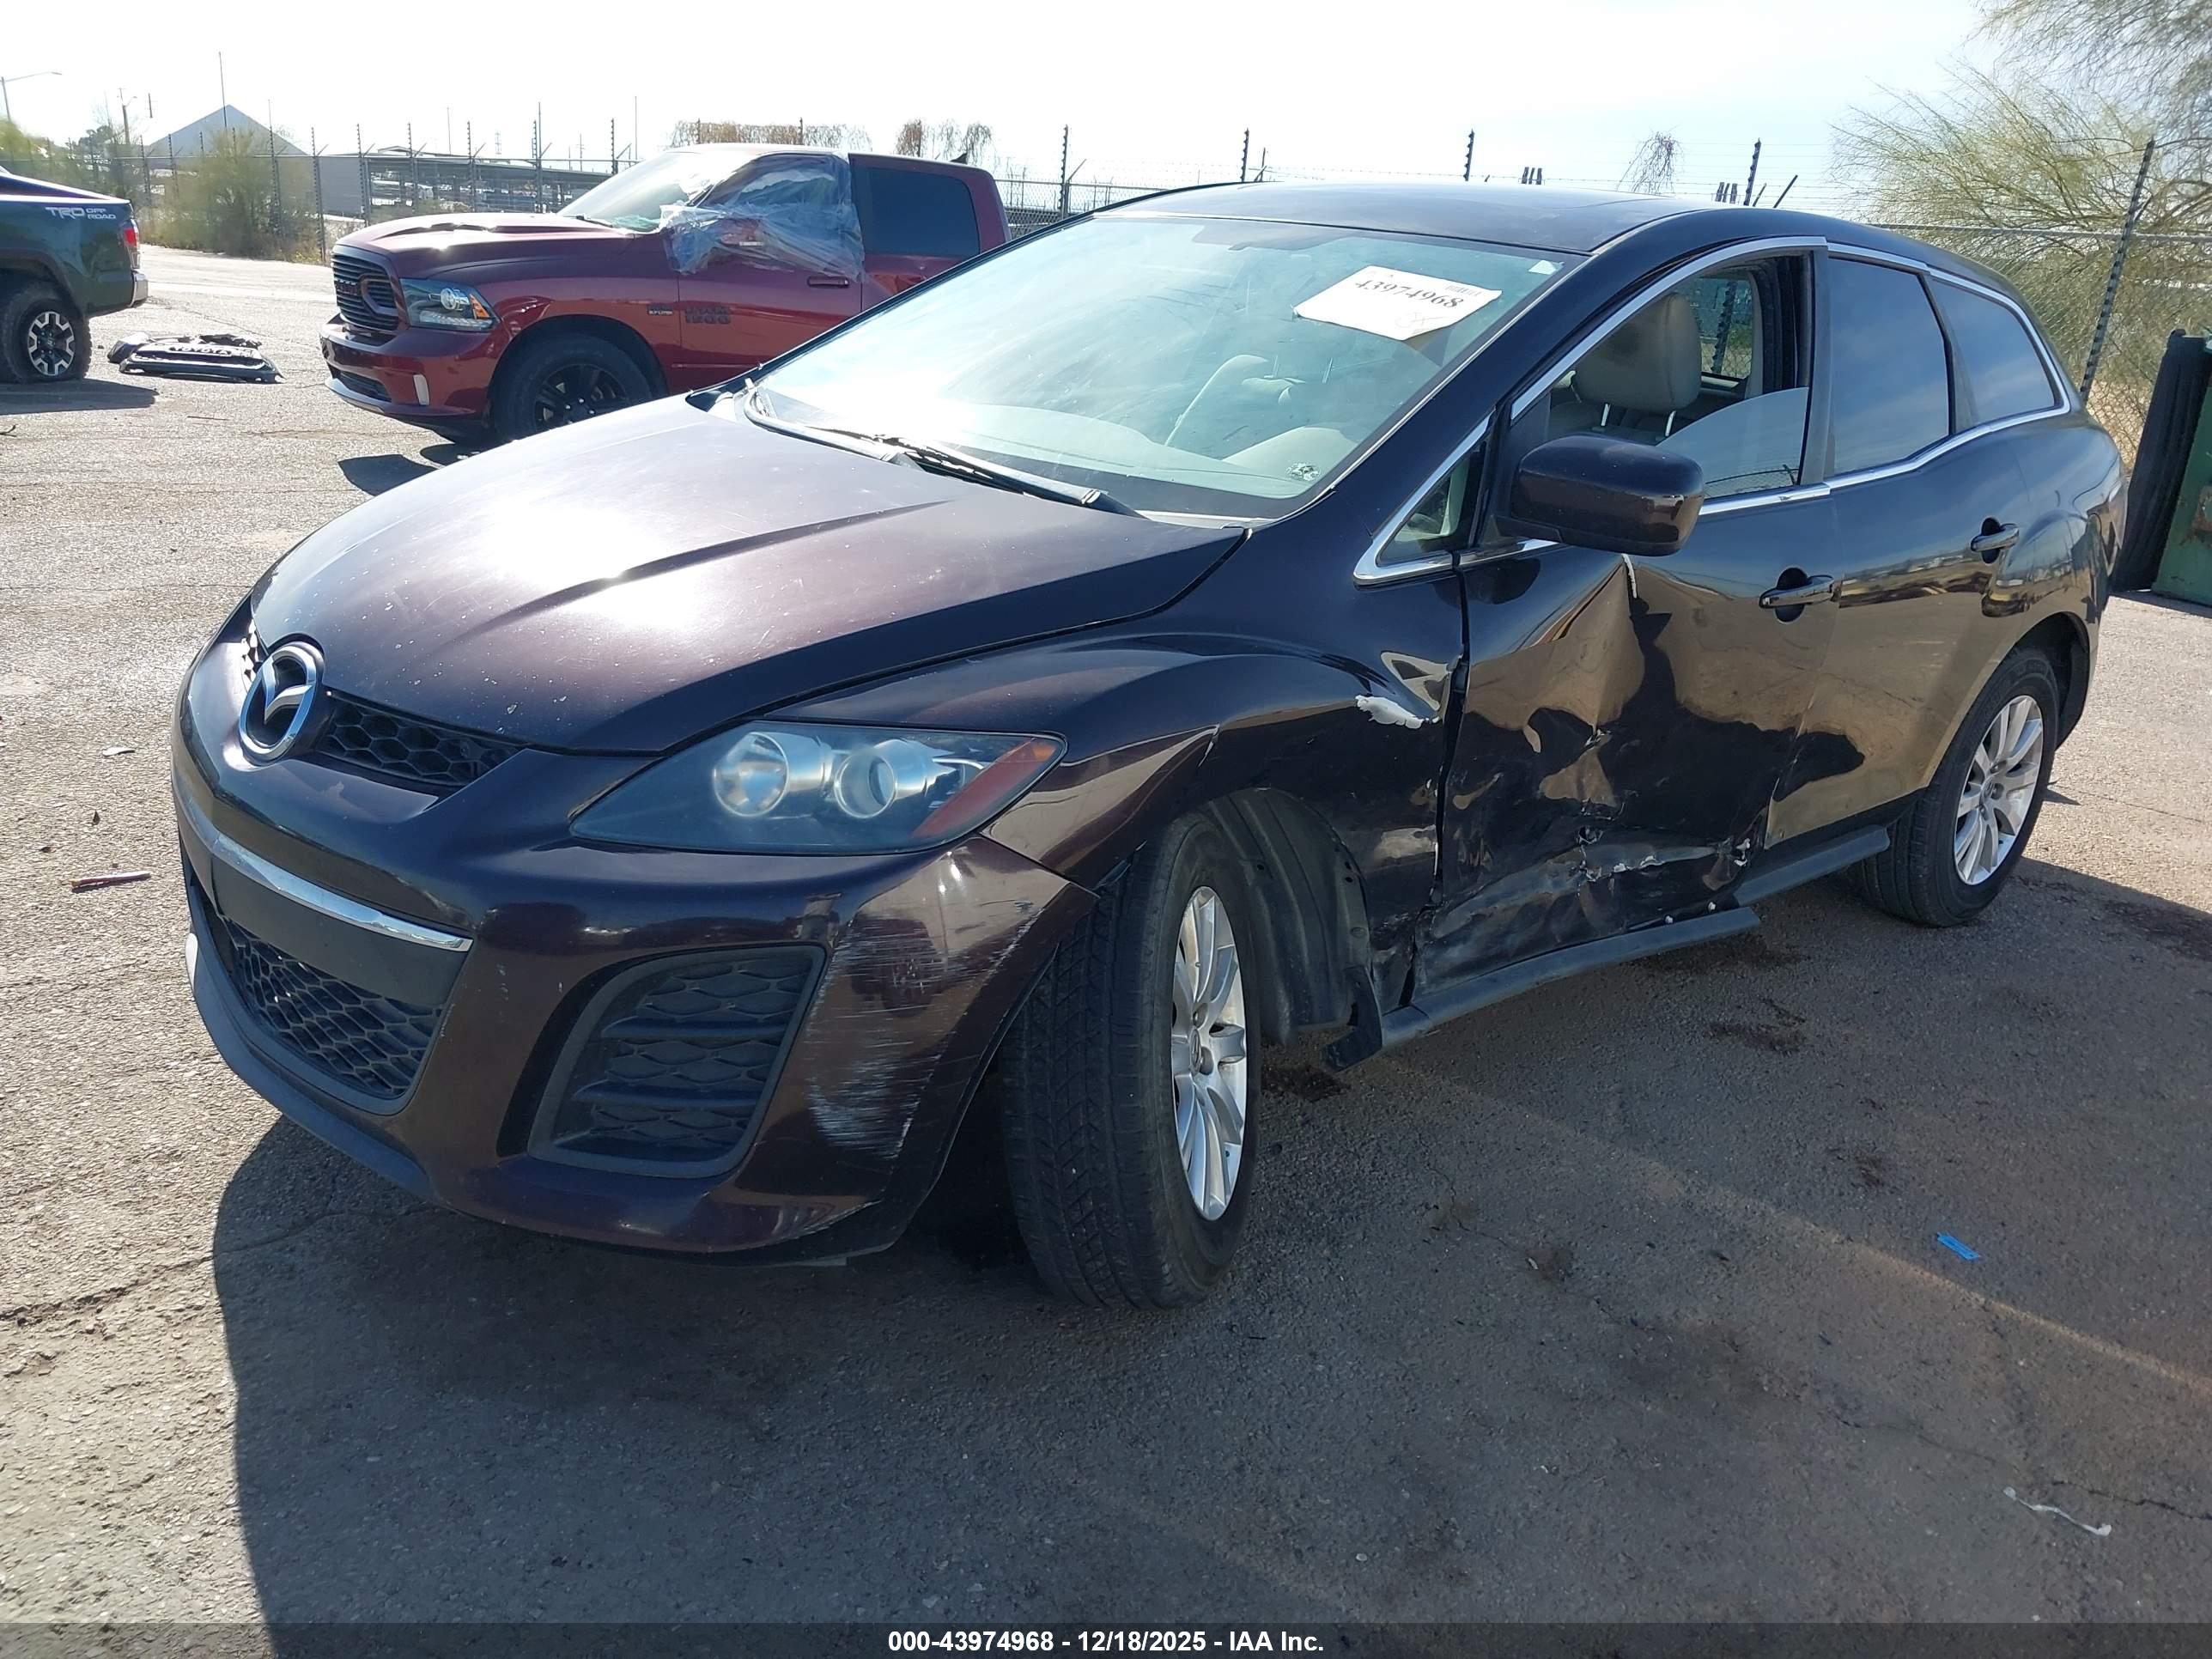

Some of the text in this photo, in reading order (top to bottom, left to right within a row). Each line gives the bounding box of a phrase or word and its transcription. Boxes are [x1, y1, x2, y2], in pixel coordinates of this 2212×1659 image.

[45, 207, 85, 220] TRD
[1354, 280, 1464, 308] 43974968
[173, 346, 229, 355] TOYOTA
